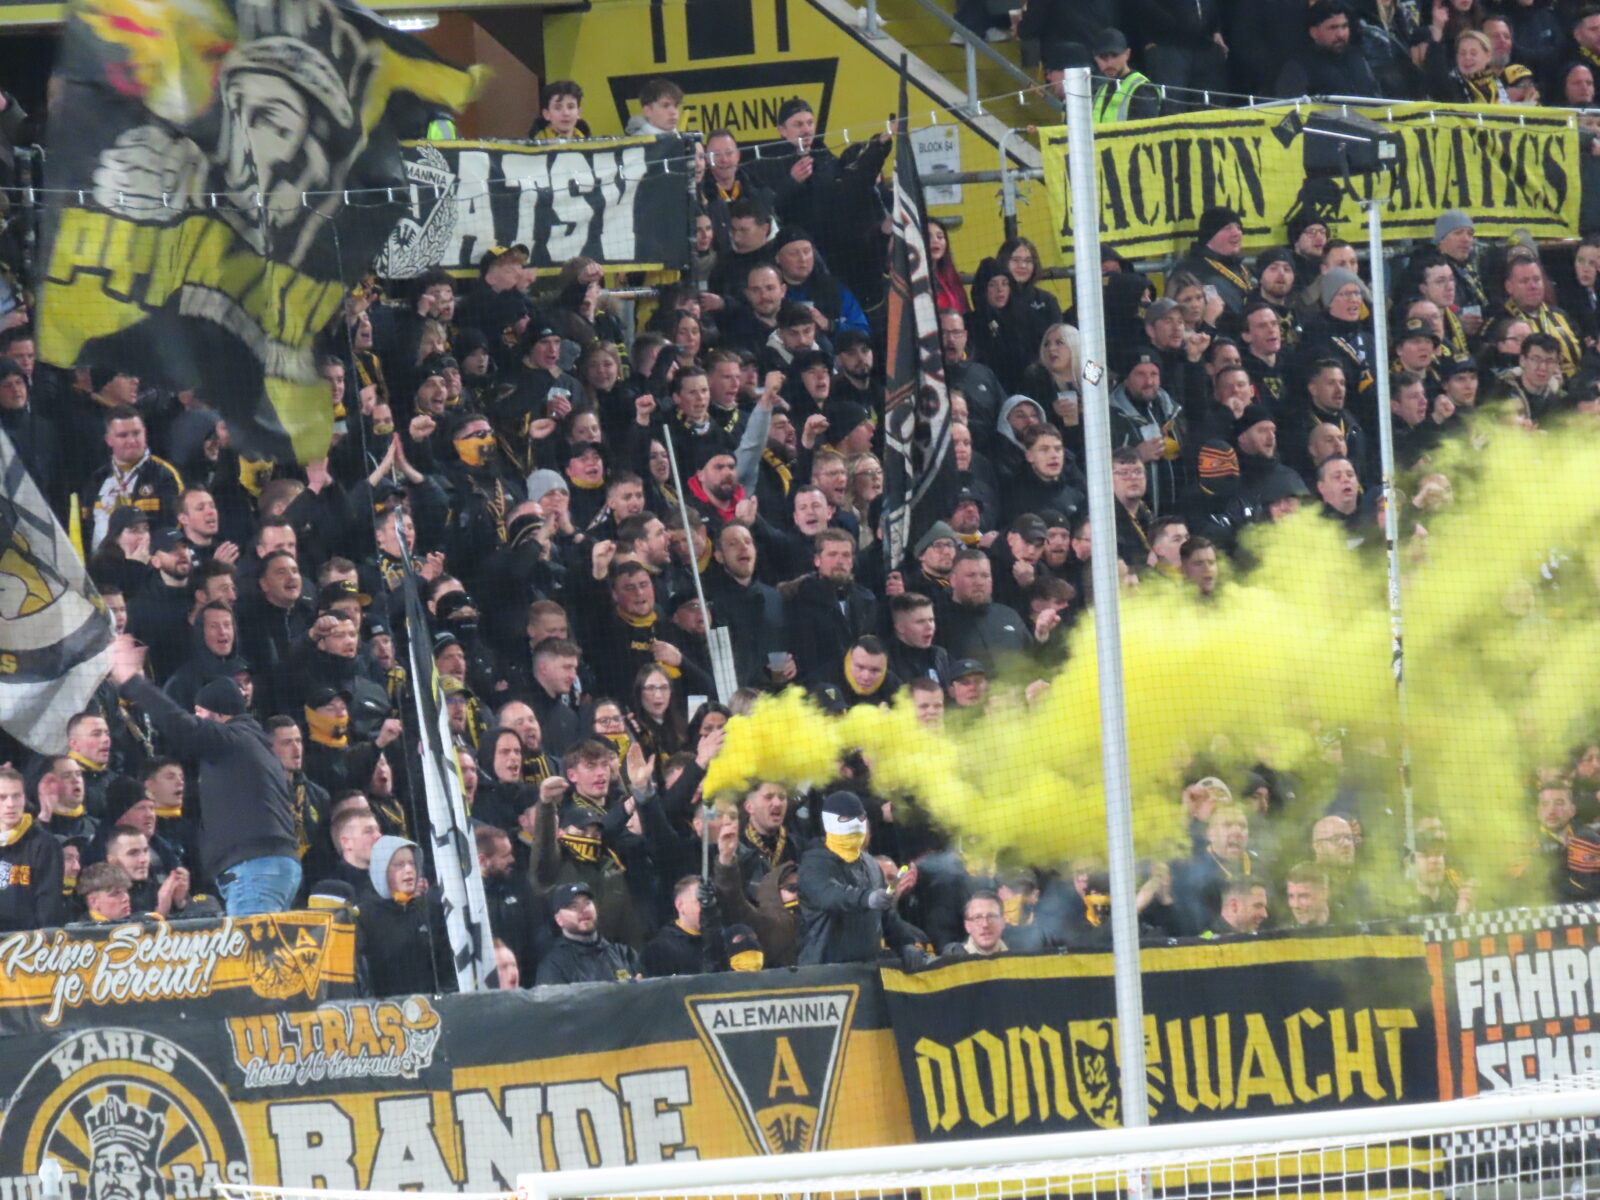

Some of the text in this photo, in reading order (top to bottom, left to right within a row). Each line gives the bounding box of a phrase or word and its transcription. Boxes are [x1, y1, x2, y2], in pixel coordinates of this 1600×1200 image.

[918, 141, 943, 153] BLOCK
[0, 917, 246, 978] Keine Sekunde
[43, 952, 216, 1023] je bereut!
[712, 1002, 840, 1030] ALEMANNIA
[51, 1029, 177, 1081] KARLS
[226, 1003, 407, 1068] ULTRAS
[769, 1036, 809, 1098] A
